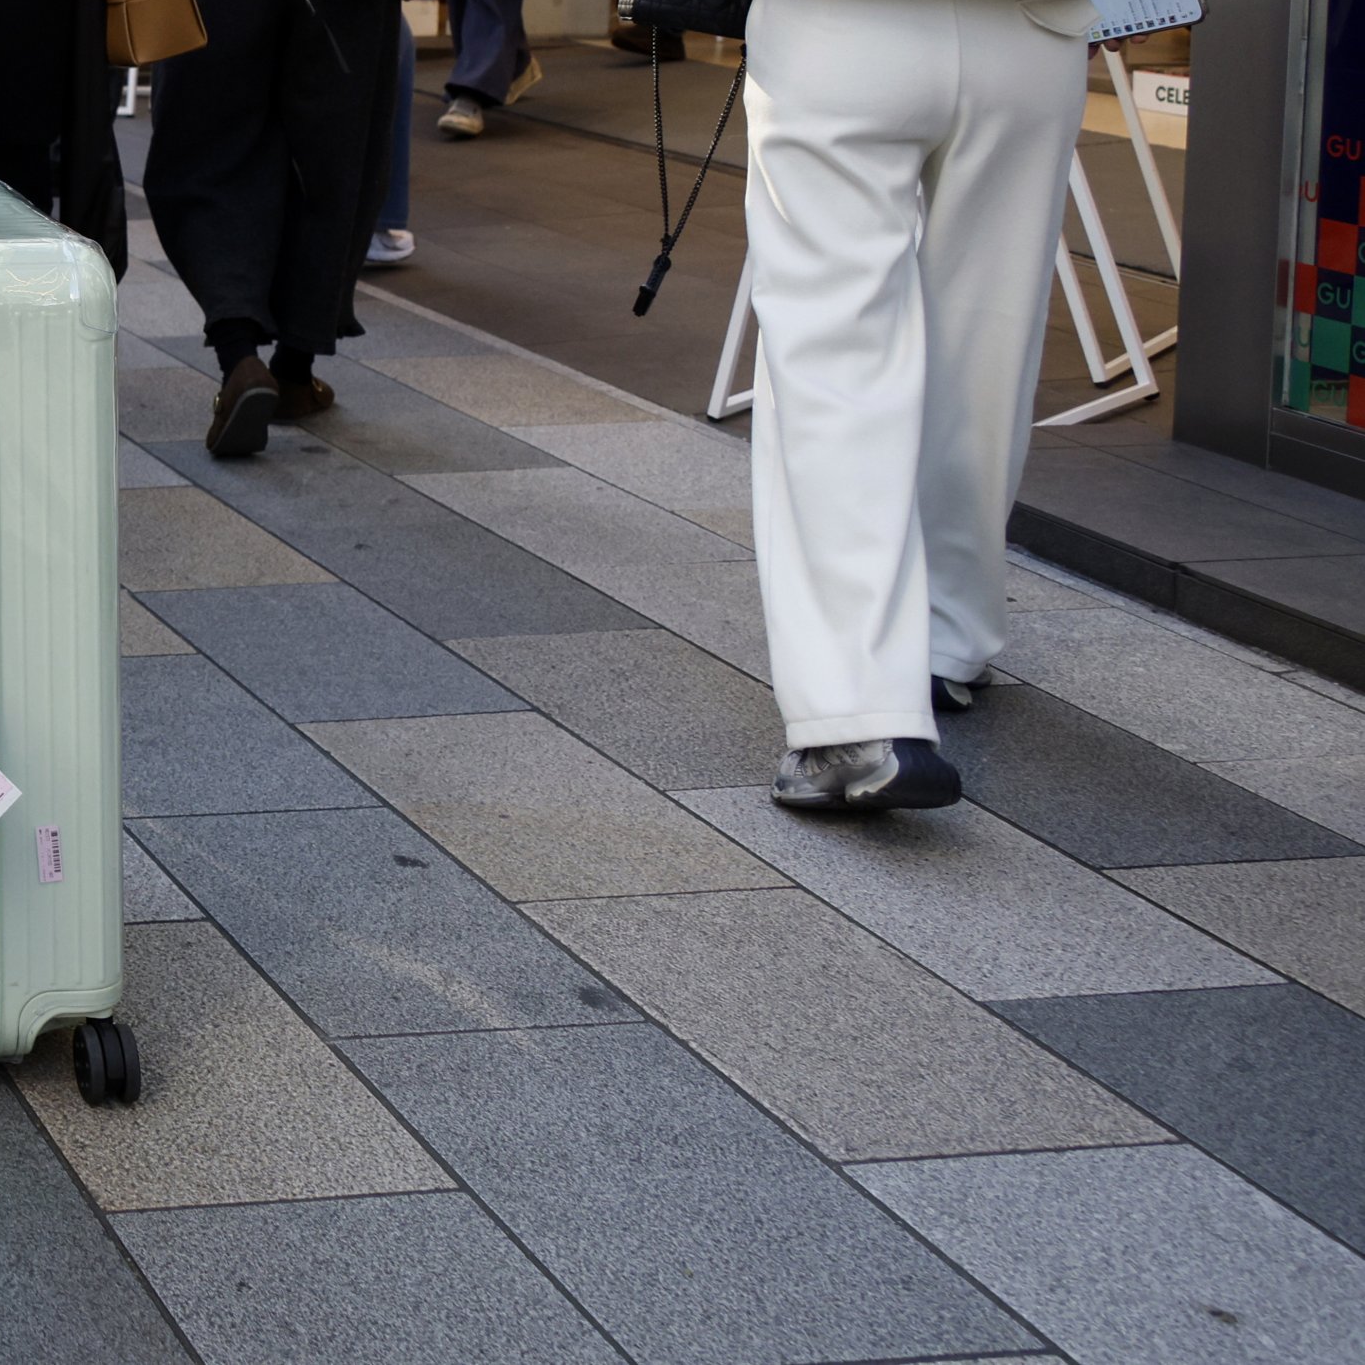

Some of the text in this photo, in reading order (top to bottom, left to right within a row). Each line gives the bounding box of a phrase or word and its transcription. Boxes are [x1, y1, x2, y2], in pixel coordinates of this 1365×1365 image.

[1326, 135, 1361, 161] GU
[1317, 282, 1351, 309] GU
[1313, 381, 1347, 407] GU
